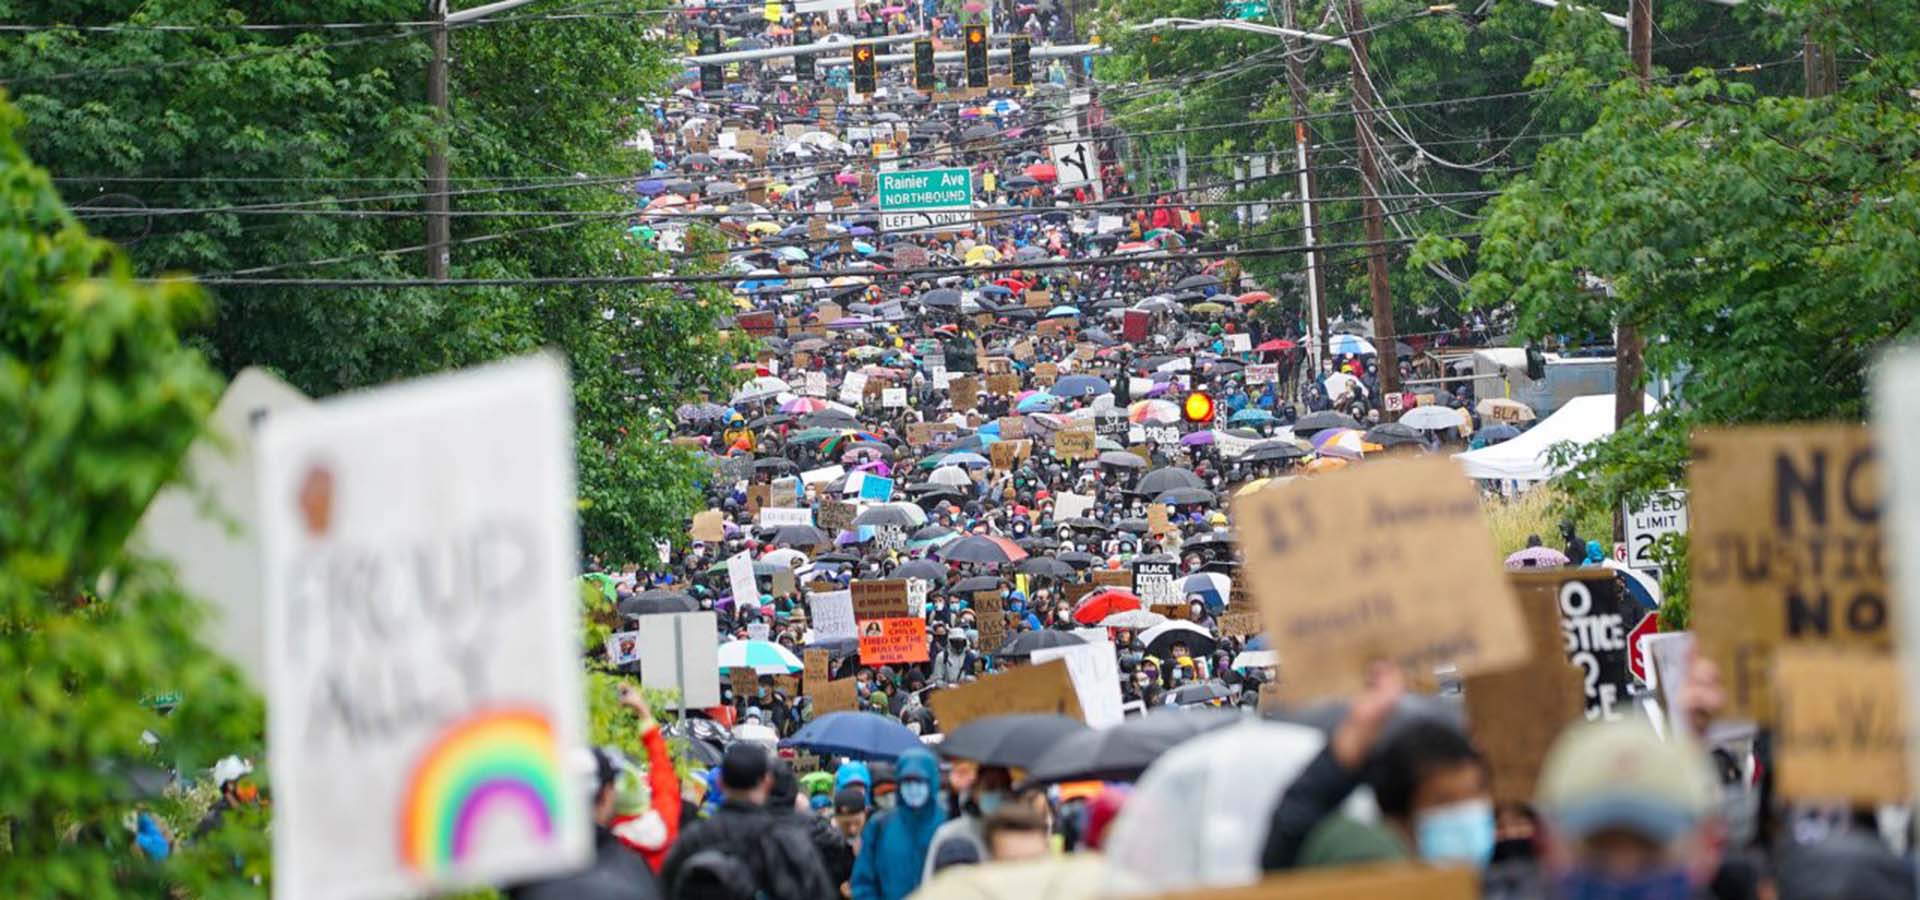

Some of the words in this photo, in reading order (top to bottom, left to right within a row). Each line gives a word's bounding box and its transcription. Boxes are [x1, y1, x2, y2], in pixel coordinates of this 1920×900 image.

[884, 175, 928, 190] Rainier
[941, 172, 965, 187] Ave
[886, 190, 966, 205] NORTHBOUND
[885, 215, 914, 228] LEFT
[935, 212, 966, 225] ONLY
[1493, 406, 1520, 421] BLM
[1636, 515, 1677, 529] LIMIT
[1139, 564, 1170, 573] BLACK
[890, 636, 901, 644] OF
[1561, 614, 1626, 652] STICE
